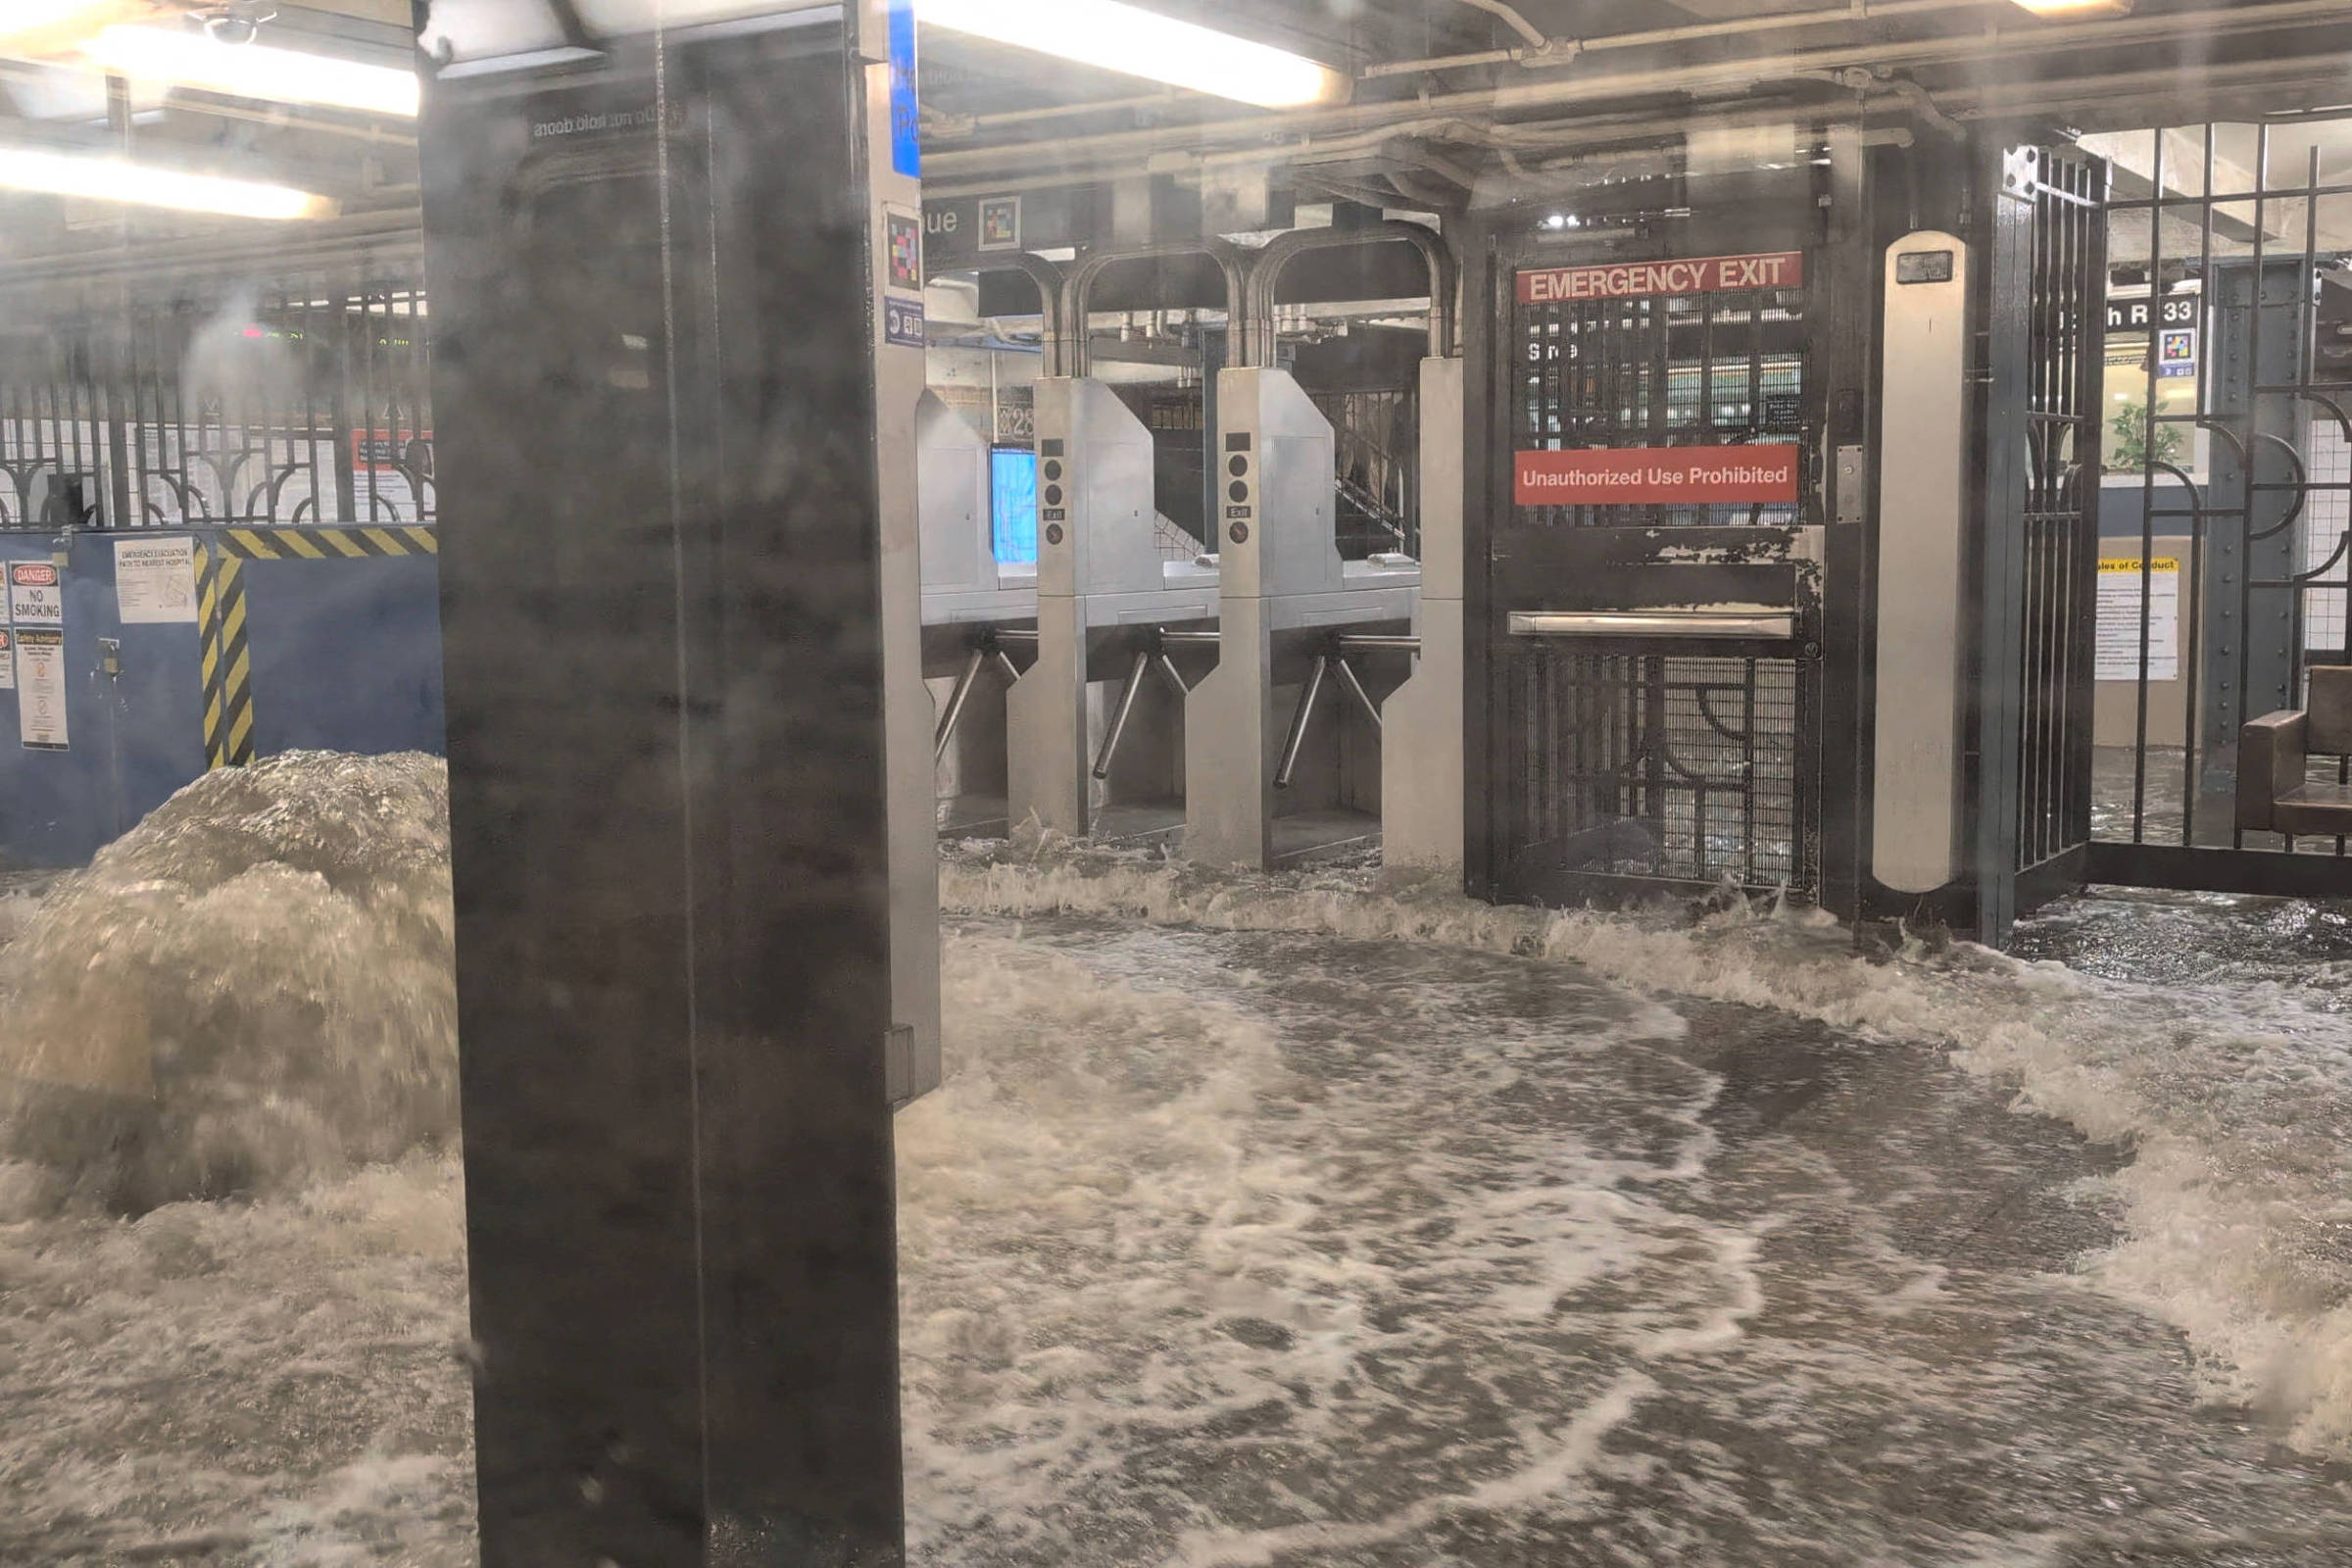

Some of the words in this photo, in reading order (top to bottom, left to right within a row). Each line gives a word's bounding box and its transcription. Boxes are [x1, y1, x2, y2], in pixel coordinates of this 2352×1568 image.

[1529, 262, 1708, 301] EMERGENCY
[1718, 257, 1787, 287] EXIT
[2163, 301, 2192, 321] 33
[1522, 467, 1642, 487] Unauthorized
[1647, 467, 1684, 485] Use
[1689, 466, 1788, 485] Prohibited
[2097, 562, 2115, 571] ules
[2119, 562, 2129, 570] of
[2131, 561, 2174, 570] Coduct
[17, 568, 53, 582] DANGER
[29, 589, 43, 603] NO
[15, 603, 60, 617] SMOKING
